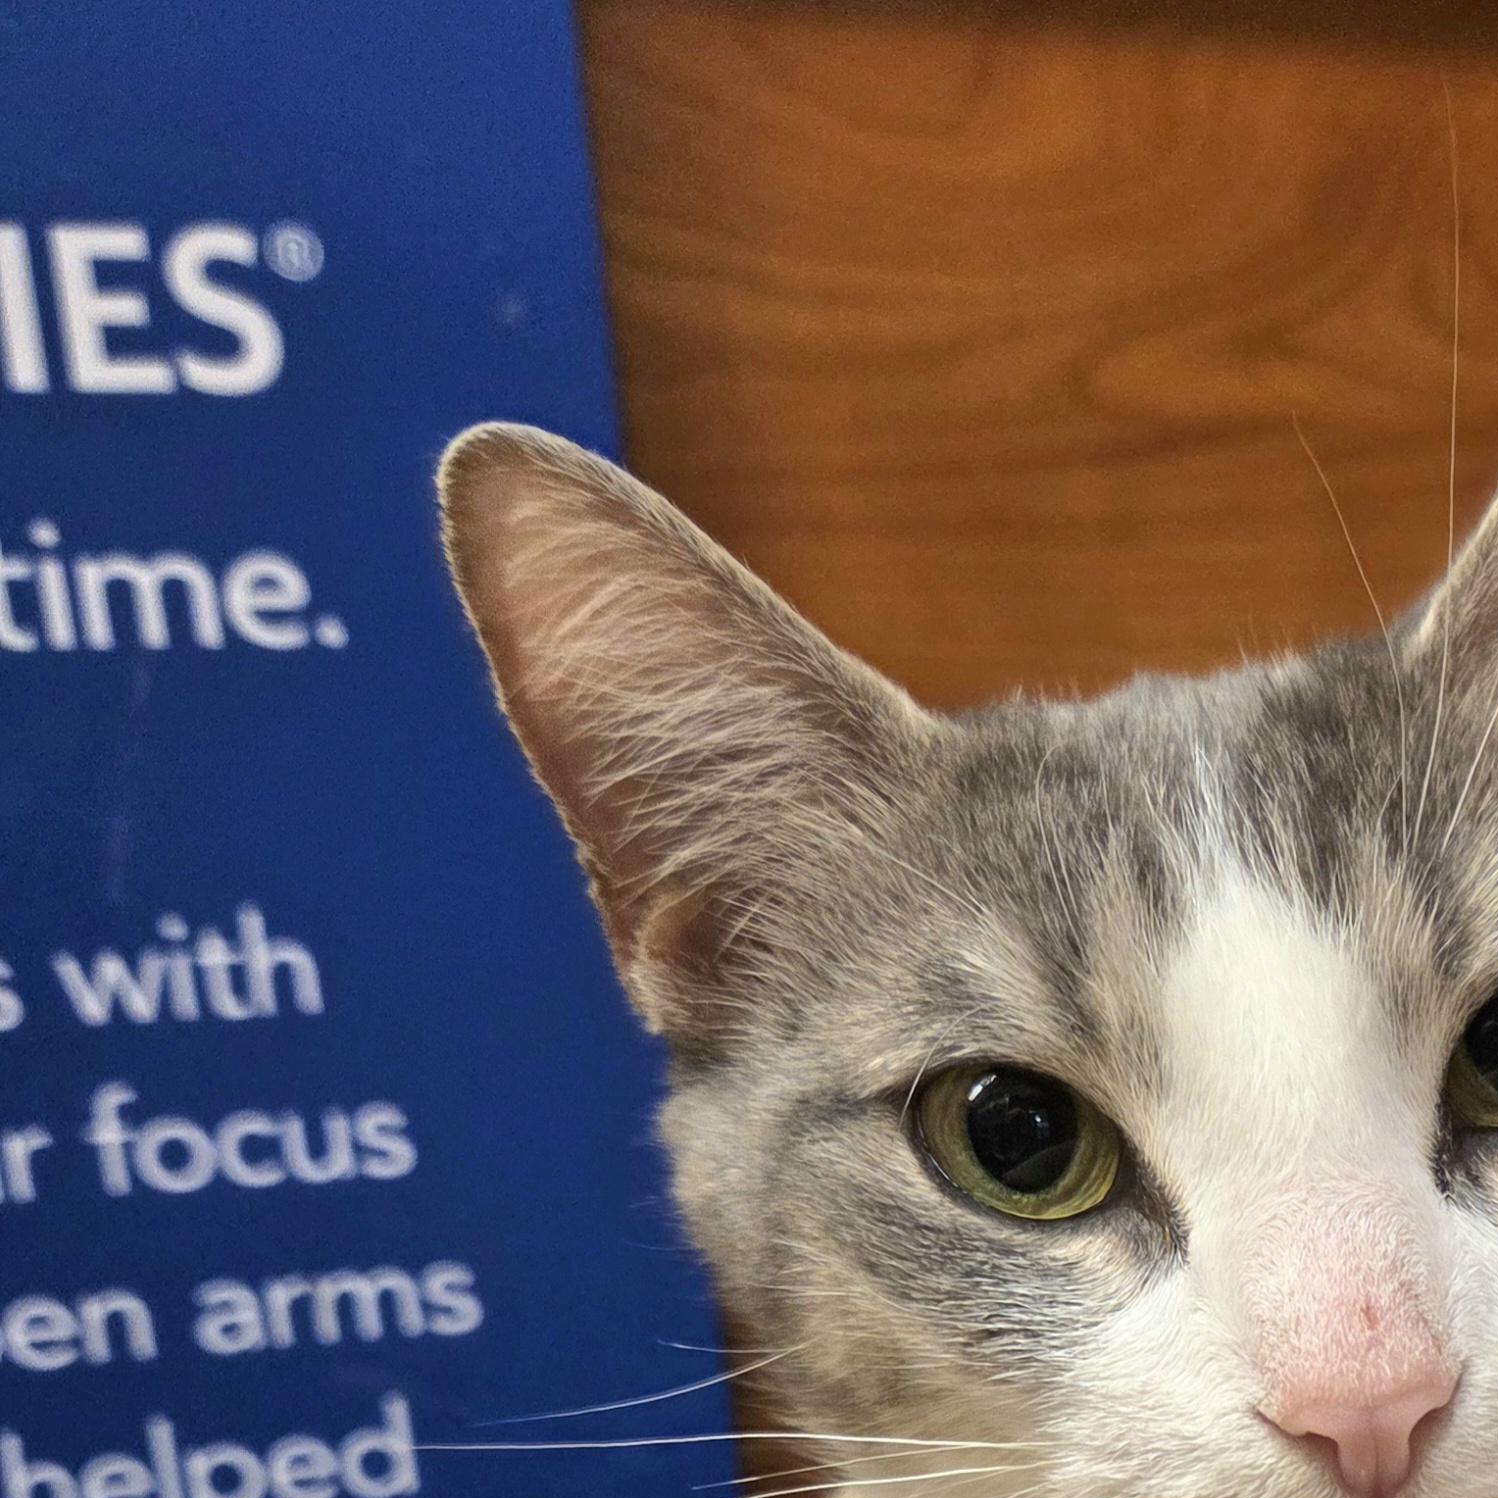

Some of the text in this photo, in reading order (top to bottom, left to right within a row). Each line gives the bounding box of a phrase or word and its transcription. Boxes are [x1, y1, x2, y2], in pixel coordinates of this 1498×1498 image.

[52, 903, 325, 1026] with
[0, 1080, 418, 1202] r focus
[0, 1259, 485, 1371] en arms
